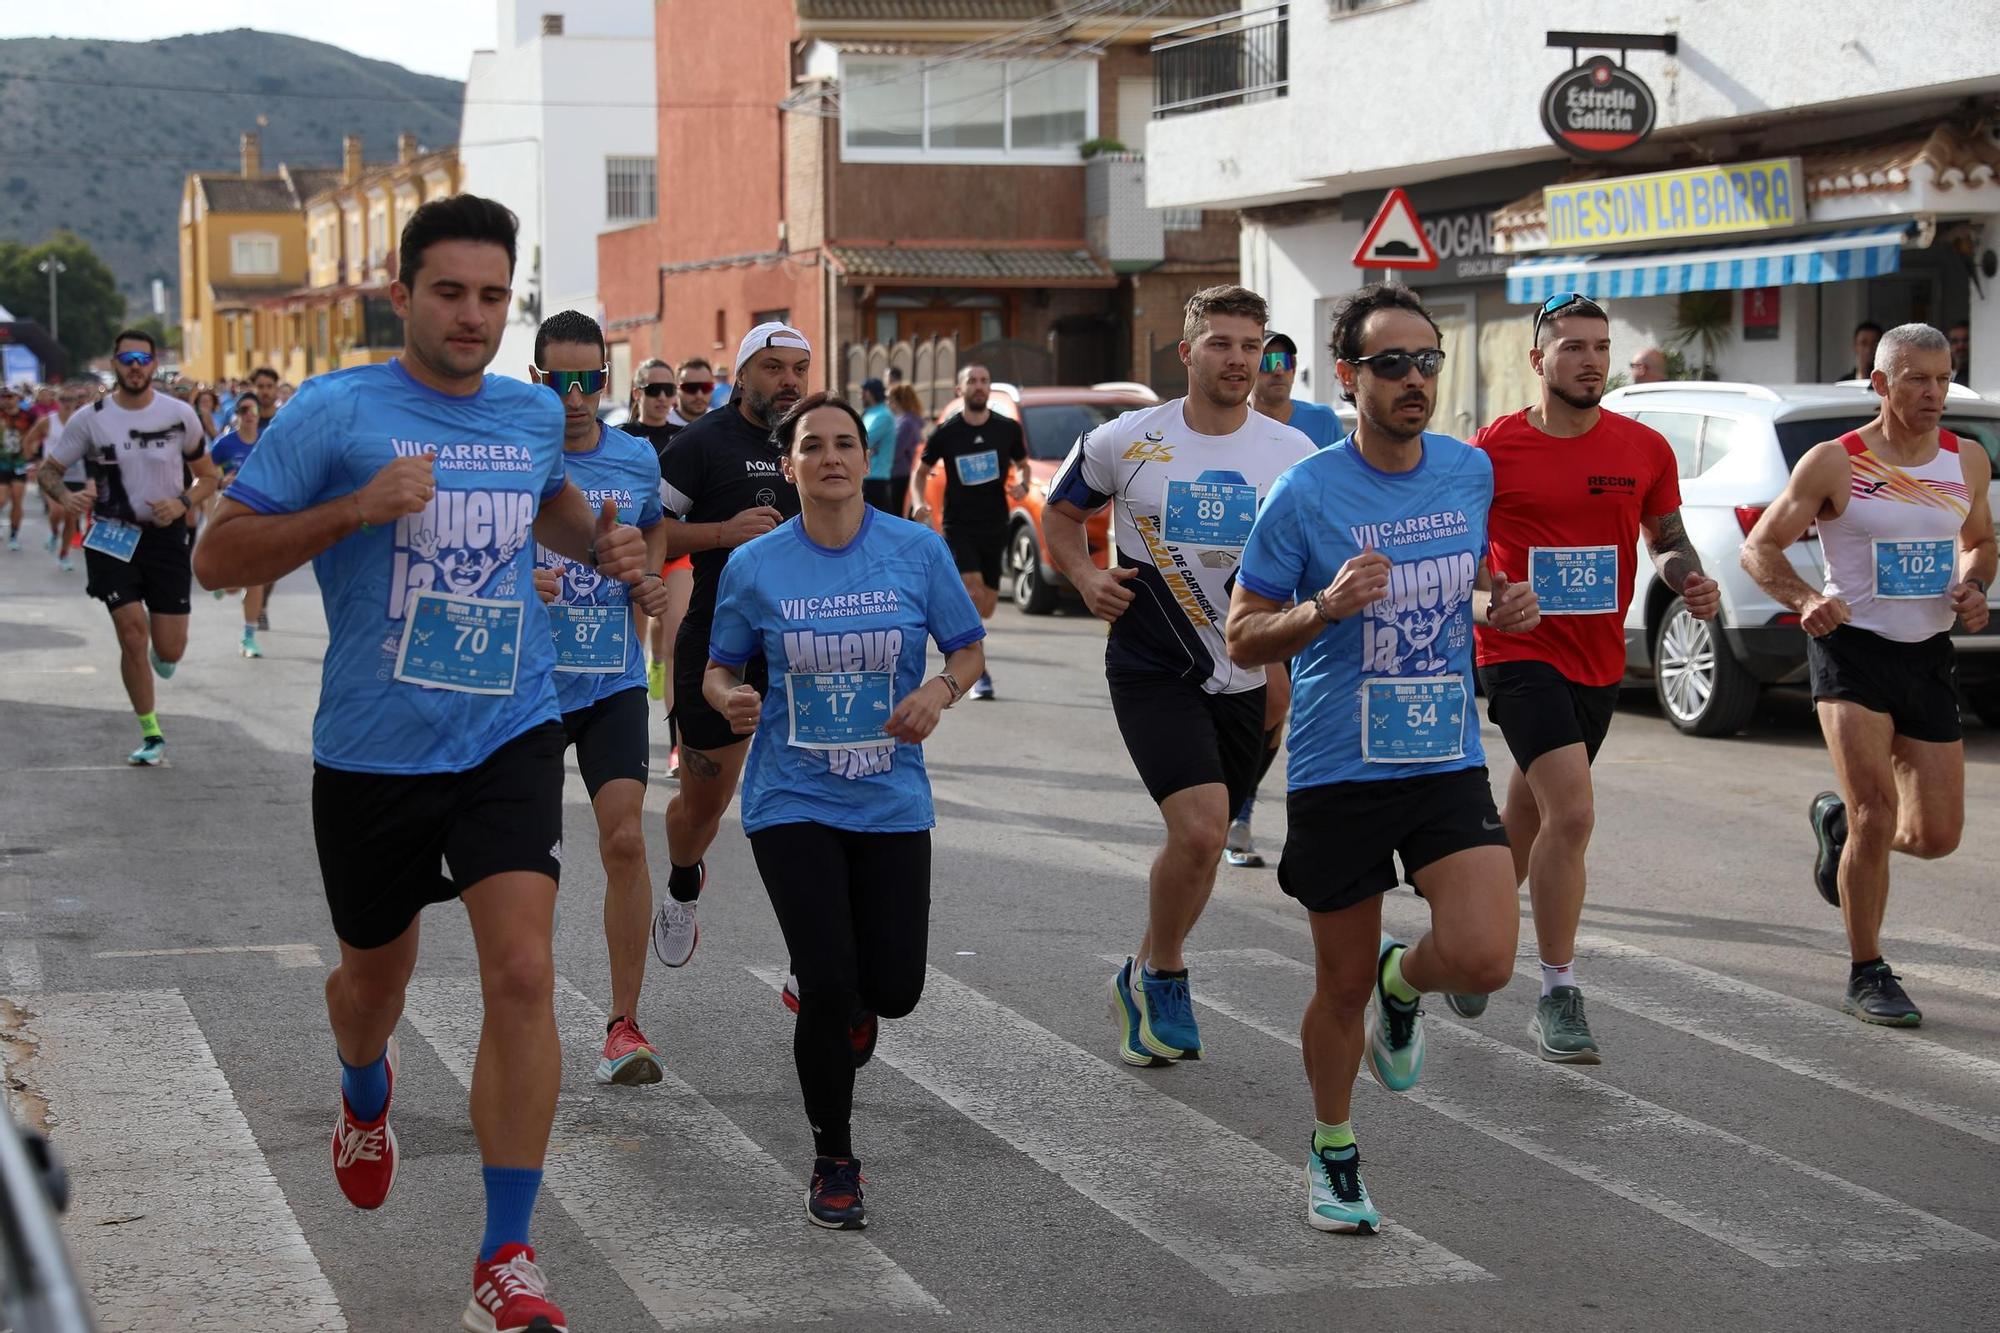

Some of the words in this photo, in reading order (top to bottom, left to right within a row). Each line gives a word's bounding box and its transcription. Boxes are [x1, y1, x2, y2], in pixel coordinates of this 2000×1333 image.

[1566, 86, 1636, 110] Estrella
[1567, 108, 1633, 130] Galicia
[1551, 184, 1648, 241] MESON
[1655, 180, 1687, 230] LA
[1691, 167, 1791, 226] BARRA
[423, 443, 532, 462] CARRERA
[439, 460, 488, 471] MARCHA
[745, 460, 777, 471] NOW
[1587, 476, 1636, 487] RECON
[1197, 499, 1225, 520] 89
[103, 528, 125, 542] 211
[1351, 523, 1380, 550] VII
[1380, 510, 1466, 536] CARRERA
[1383, 538, 1390, 548] Y
[1393, 531, 1432, 546] MARCHA
[1434, 524, 1469, 539] URBANA
[1135, 515, 1174, 569] PLAZA
[1164, 573, 1210, 629] MAYOR
[1898, 556, 1936, 574] 102
[1557, 567, 1597, 586] 126
[780, 599, 806, 620] VII
[807, 590, 898, 611] CARRERA
[1181, 569, 1219, 623] CARTAGENA
[809, 610, 815, 619] Y
[819, 607, 860, 618] MARCHA
[862, 603, 898, 615] URBANA
[1455, 612, 1464, 624] EL
[454, 624, 489, 654] 70
[575, 623, 600, 642] 87
[783, 628, 903, 673] Mueve
[1361, 621, 1398, 672] la
[826, 692, 857, 715] 17
[1407, 703, 1438, 728] 54
